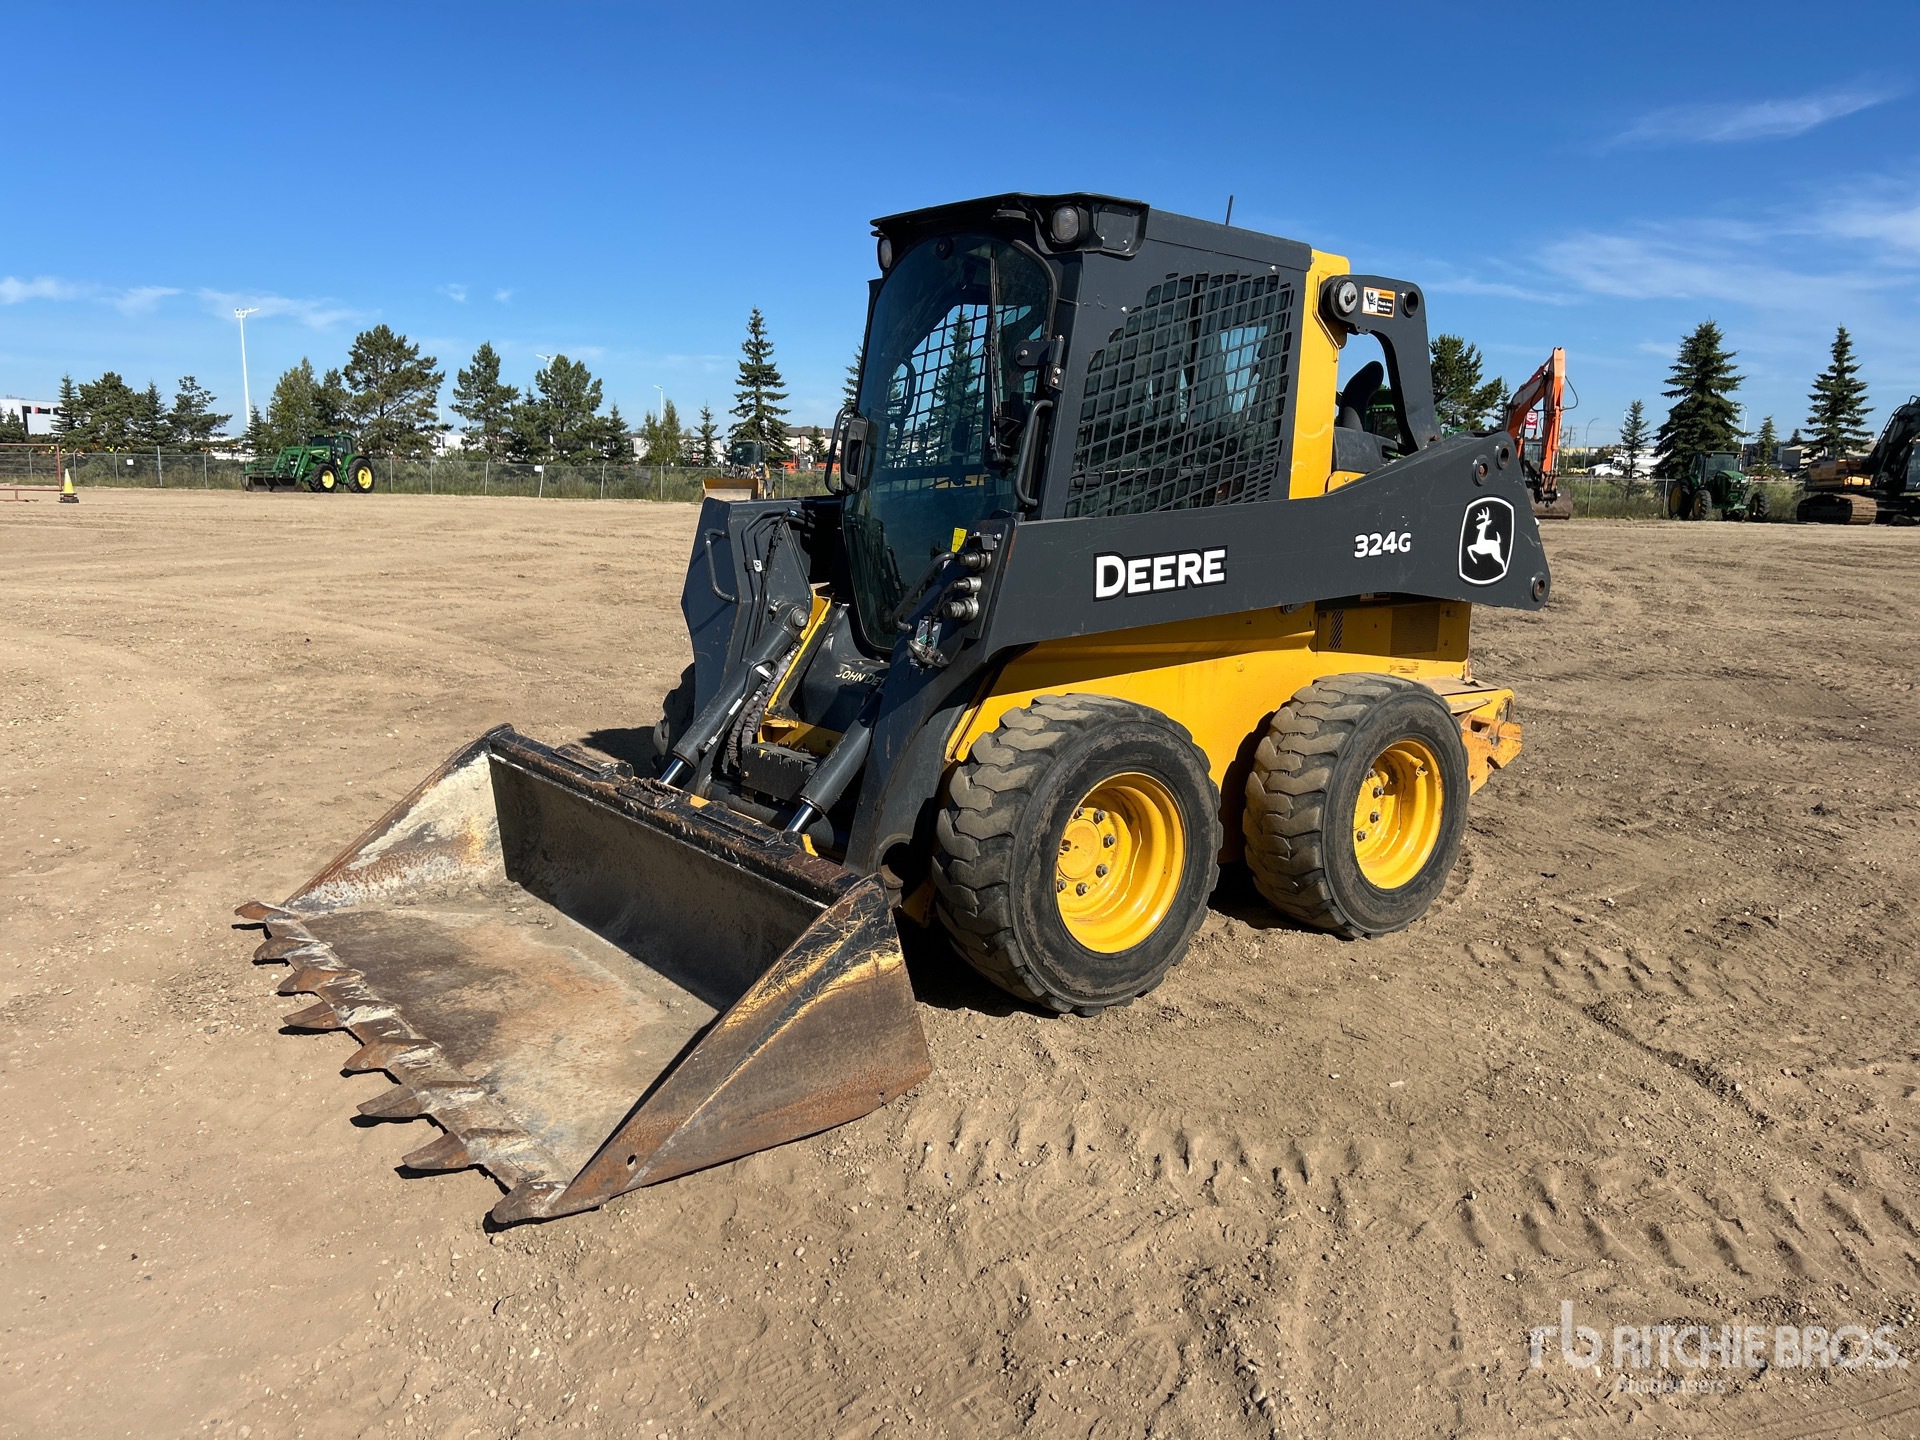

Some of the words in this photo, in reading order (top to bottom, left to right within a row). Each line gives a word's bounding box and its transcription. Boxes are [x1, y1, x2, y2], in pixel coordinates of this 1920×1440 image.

[1354, 530, 1412, 558] 324G
[1095, 549, 1226, 599] DEERE
[835, 670, 866, 682] JOHN
